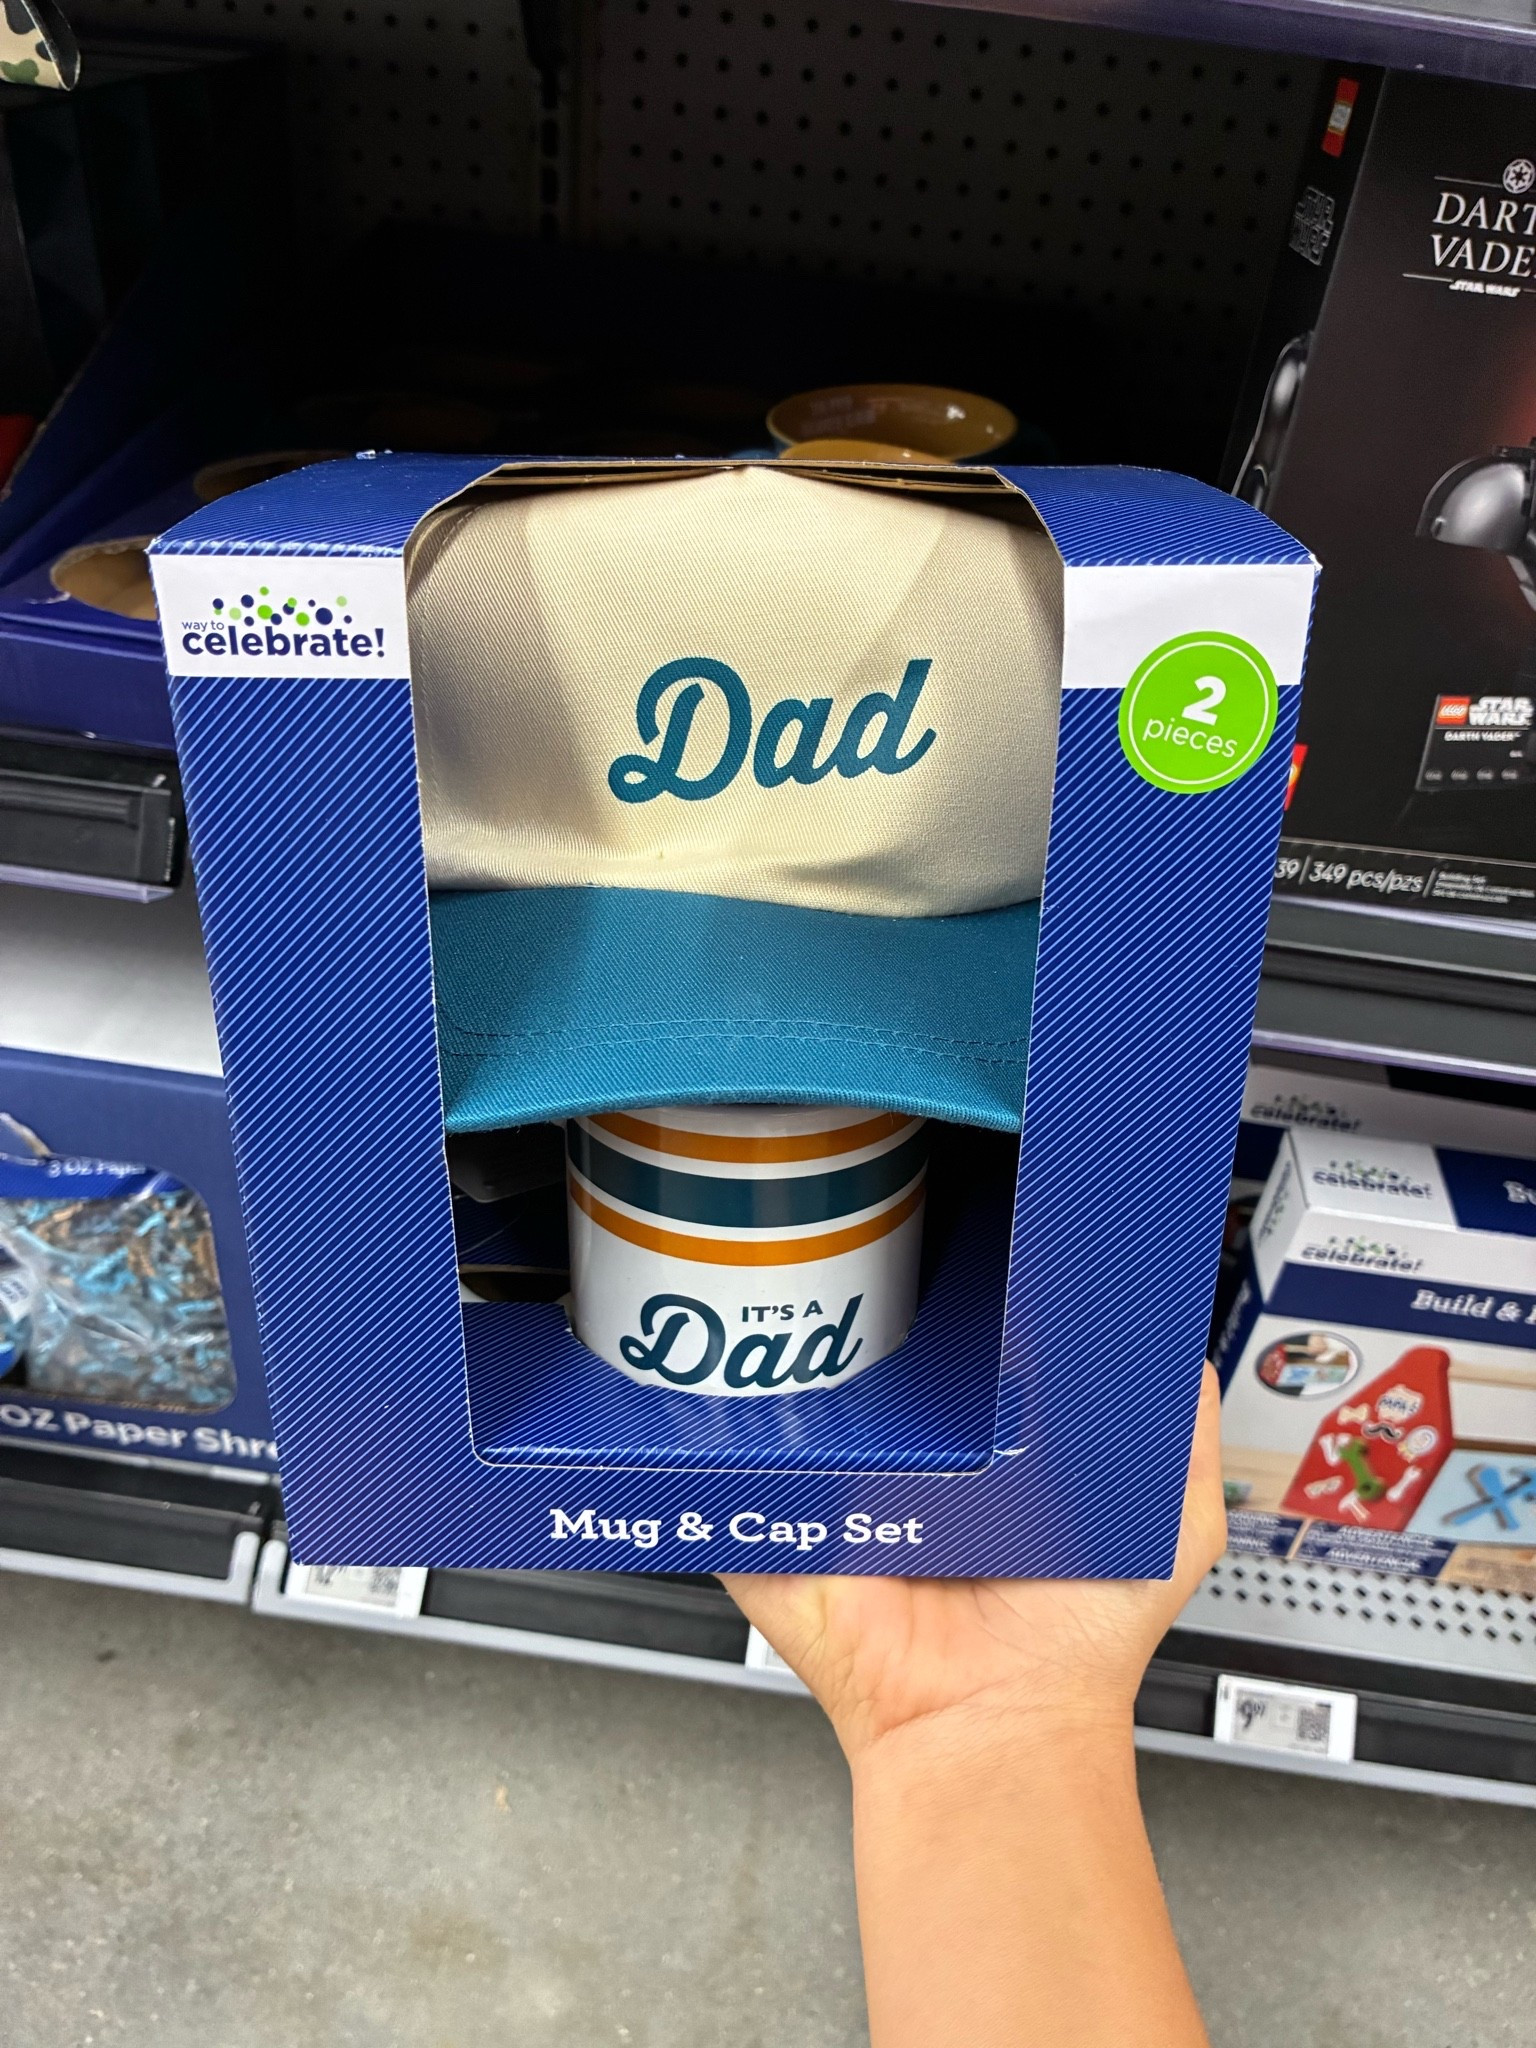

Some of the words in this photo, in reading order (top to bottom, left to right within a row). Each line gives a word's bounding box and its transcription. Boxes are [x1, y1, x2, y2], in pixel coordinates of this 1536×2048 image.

[1430, 234, 1536, 279] VADE
[181, 620, 208, 632] way
[210, 620, 225, 631] to
[182, 625, 385, 658] celebrate!
[1181, 675, 1227, 726] 2
[1469, 696, 1534, 713] STAR
[608, 656, 937, 804] Dad
[1142, 717, 1238, 758] pieces
[1309, 860, 1347, 883] 349
[1346, 868, 1424, 894] pcs/pzs
[802, 1300, 823, 1318] A
[1410, 1288, 1495, 1319] Build
[1495, 1301, 1522, 1323] &
[619, 1293, 864, 1388] Dad
[61, 1410, 188, 1447] Paper
[549, 1508, 662, 1548] Mug
[676, 1511, 714, 1542] &
[728, 1511, 828, 1552] Cap
[842, 1513, 924, 1544] Set
